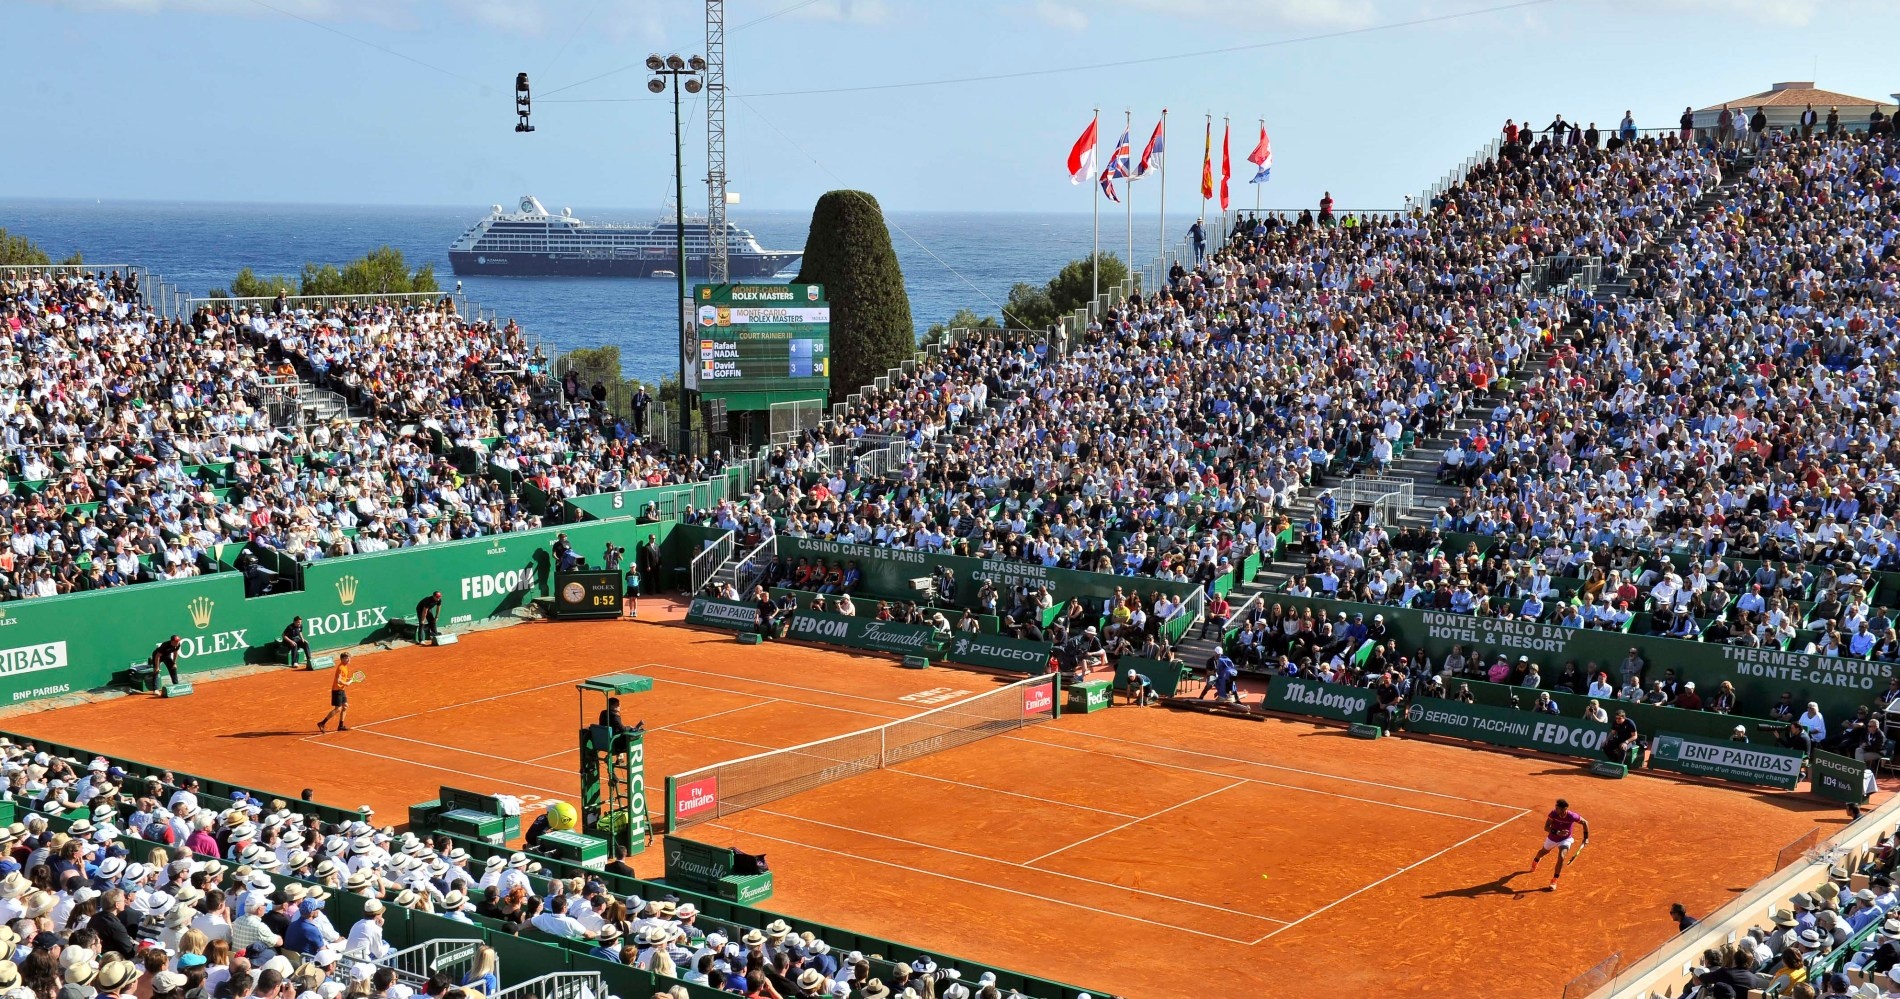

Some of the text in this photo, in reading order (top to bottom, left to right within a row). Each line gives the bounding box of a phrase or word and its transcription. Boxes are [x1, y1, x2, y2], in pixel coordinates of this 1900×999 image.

[732, 292, 794, 300] ROLEX MASTERS
[748, 315, 804, 323] ROLEX MASTERS
[714, 342, 737, 350] Rafael
[714, 350, 740, 358] NADAL
[790, 344, 824, 352] 4 30
[714, 361, 735, 370] David
[714, 369, 742, 378] GOFFIN
[791, 363, 824, 372] 3 30
[613, 496, 623, 509] S
[487, 546, 507, 555] ROLEX
[798, 539, 925, 564] CASINO CAFE DE PARIS
[982, 560, 1047, 578] BRASSERIE
[461, 567, 535, 600] FEDCOM
[1023, 577, 1056, 591] PARIS
[593, 595, 615, 606] 0:52
[450, 613, 472, 624] FEDCOM
[706, 604, 757, 620] BNP PARIB
[0, 617, 17, 626] LEX
[307, 606, 389, 638] ROLEX
[791, 615, 848, 638] FEDCOM
[1422, 612, 1576, 641] MONTE-CARLO BAY
[155, 628, 250, 659] OLEX
[1429, 625, 1566, 652] HOTEL & RESORT
[970, 644, 1045, 663] PEUGEOT
[1722, 646, 1893, 678] THERMES MARINS
[1737, 661, 1874, 690] MONTE-CARLO
[13, 683, 70, 700] BNP PARIBAS
[1035, 690, 1045, 700] Fly
[1283, 682, 1366, 716] Malongo
[1025, 694, 1052, 709] Emirates
[1425, 709, 1530, 736] SERGIO TACCHINI
[1684, 744, 1793, 772] BNP PARIBAS
[1691, 762, 1714, 772] banque
[1715, 766, 1729, 774] d'un
[1730, 769, 1753, 777] monde
[1765, 774, 1790, 784] change
[1815, 757, 1862, 776] PEUGEOT
[1823, 775, 1837, 787] 104
[630, 743, 645, 836] RICOH
[691, 787, 703, 798] Fly
[678, 792, 714, 812] Emirates
[453, 947, 475, 963] SECOURS
